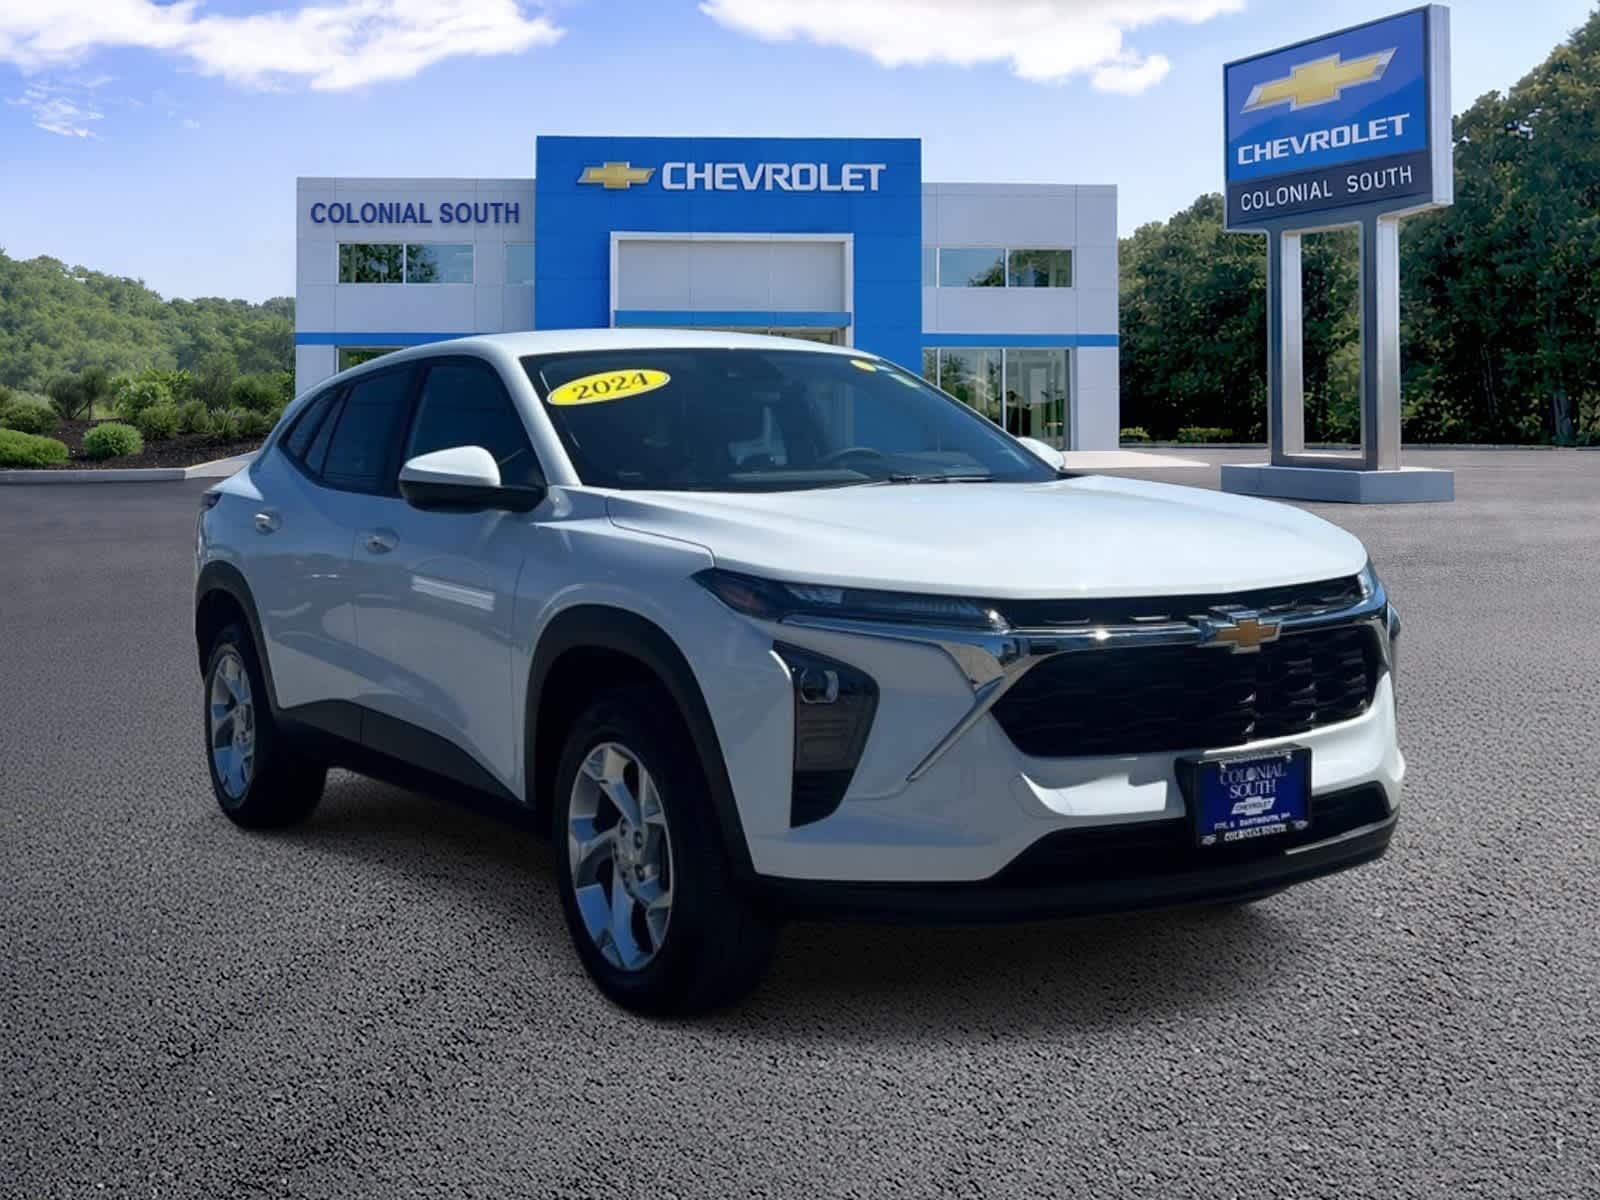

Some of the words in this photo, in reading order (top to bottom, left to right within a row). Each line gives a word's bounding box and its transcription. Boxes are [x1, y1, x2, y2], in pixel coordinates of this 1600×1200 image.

[1237, 112, 1410, 165] CHEVROLET
[661, 161, 887, 193] CHEVROLET
[1240, 179, 1333, 211] COLONIAL
[1346, 165, 1413, 193] SOUTH
[310, 201, 433, 225] COLONIAL
[439, 201, 521, 224] SOUTH
[572, 372, 649, 400] 2024
[1219, 762, 1287, 785] COLONIAL
[1229, 779, 1277, 799] SOUTH
